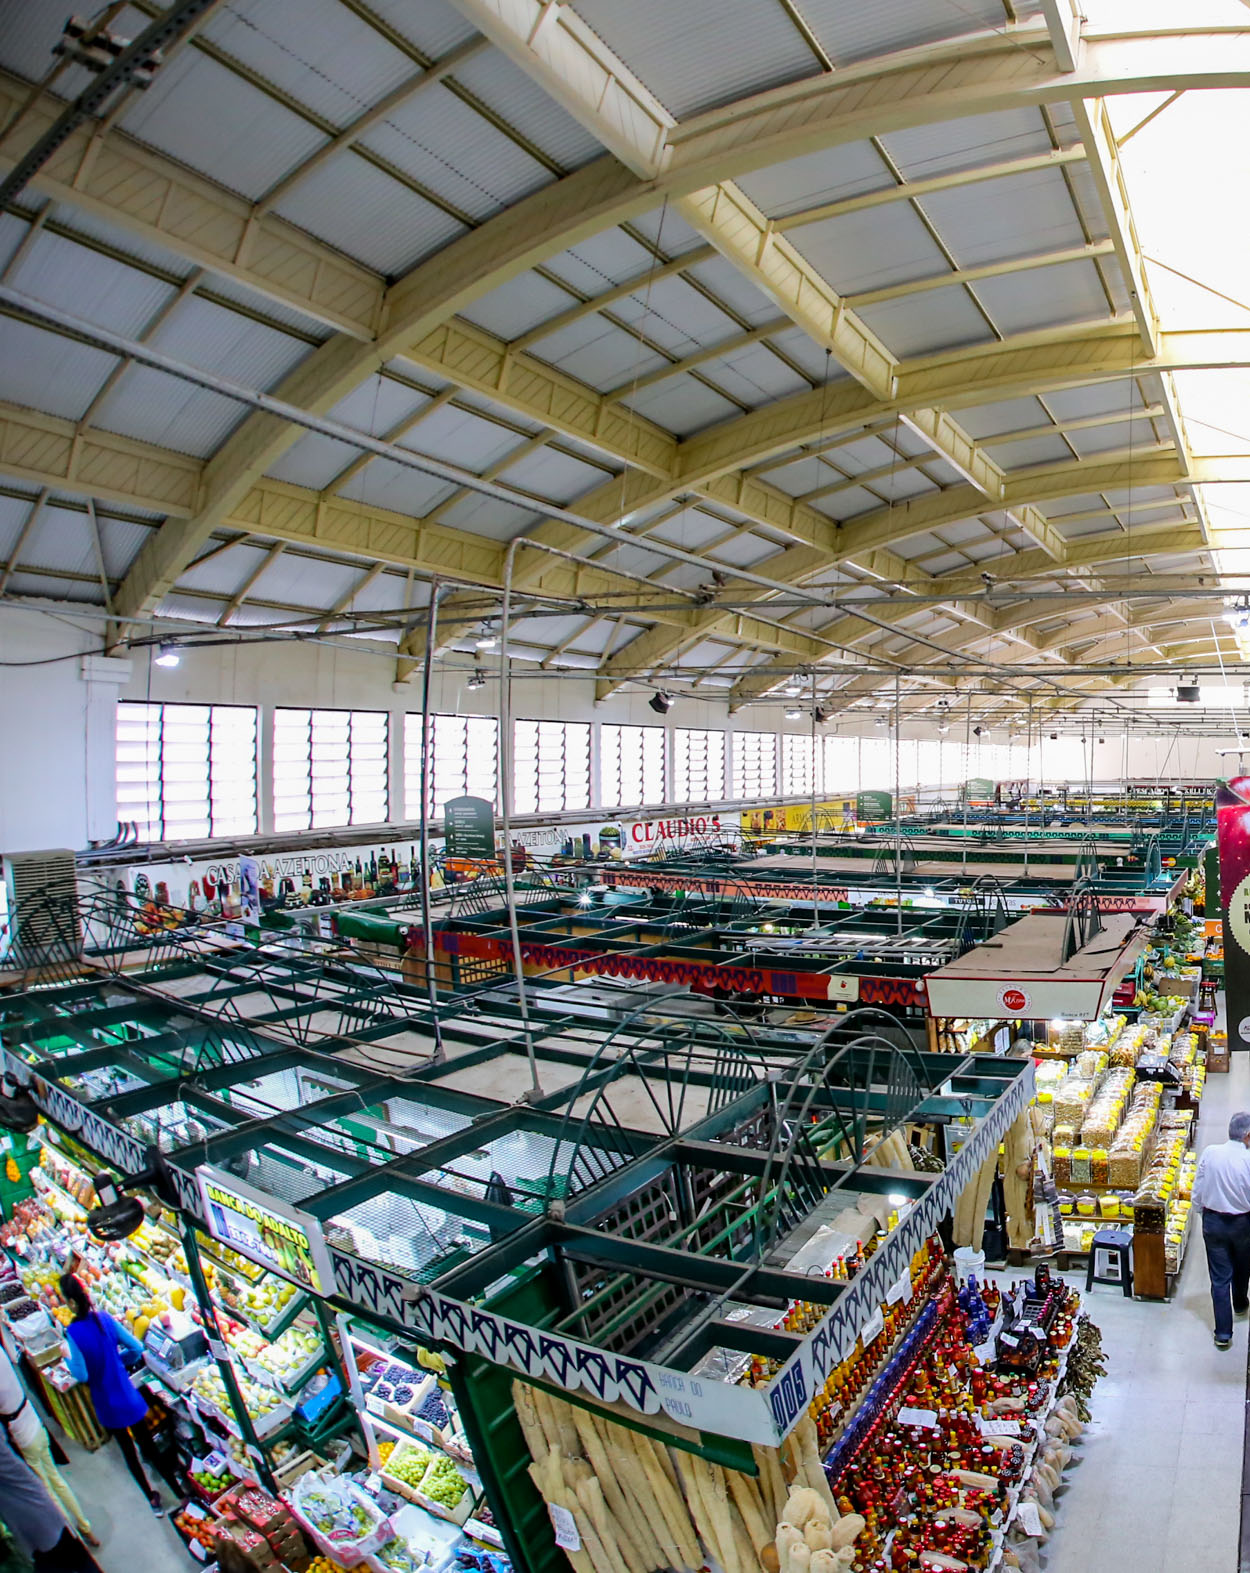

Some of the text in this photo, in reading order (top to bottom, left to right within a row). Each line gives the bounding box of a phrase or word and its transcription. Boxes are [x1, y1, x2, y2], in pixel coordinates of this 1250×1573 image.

[632, 816, 720, 842] CLAUDIO'S
[272, 852, 352, 880] AZEITONA
[206, 1183, 246, 1213] BANCA
[245, 1205, 263, 1224] DO
[263, 1212, 310, 1250] ADALTO
[658, 1373, 702, 1397] BANCA DO
[773, 1367, 805, 1426] 005
[665, 1398, 692, 1417] PAULO
